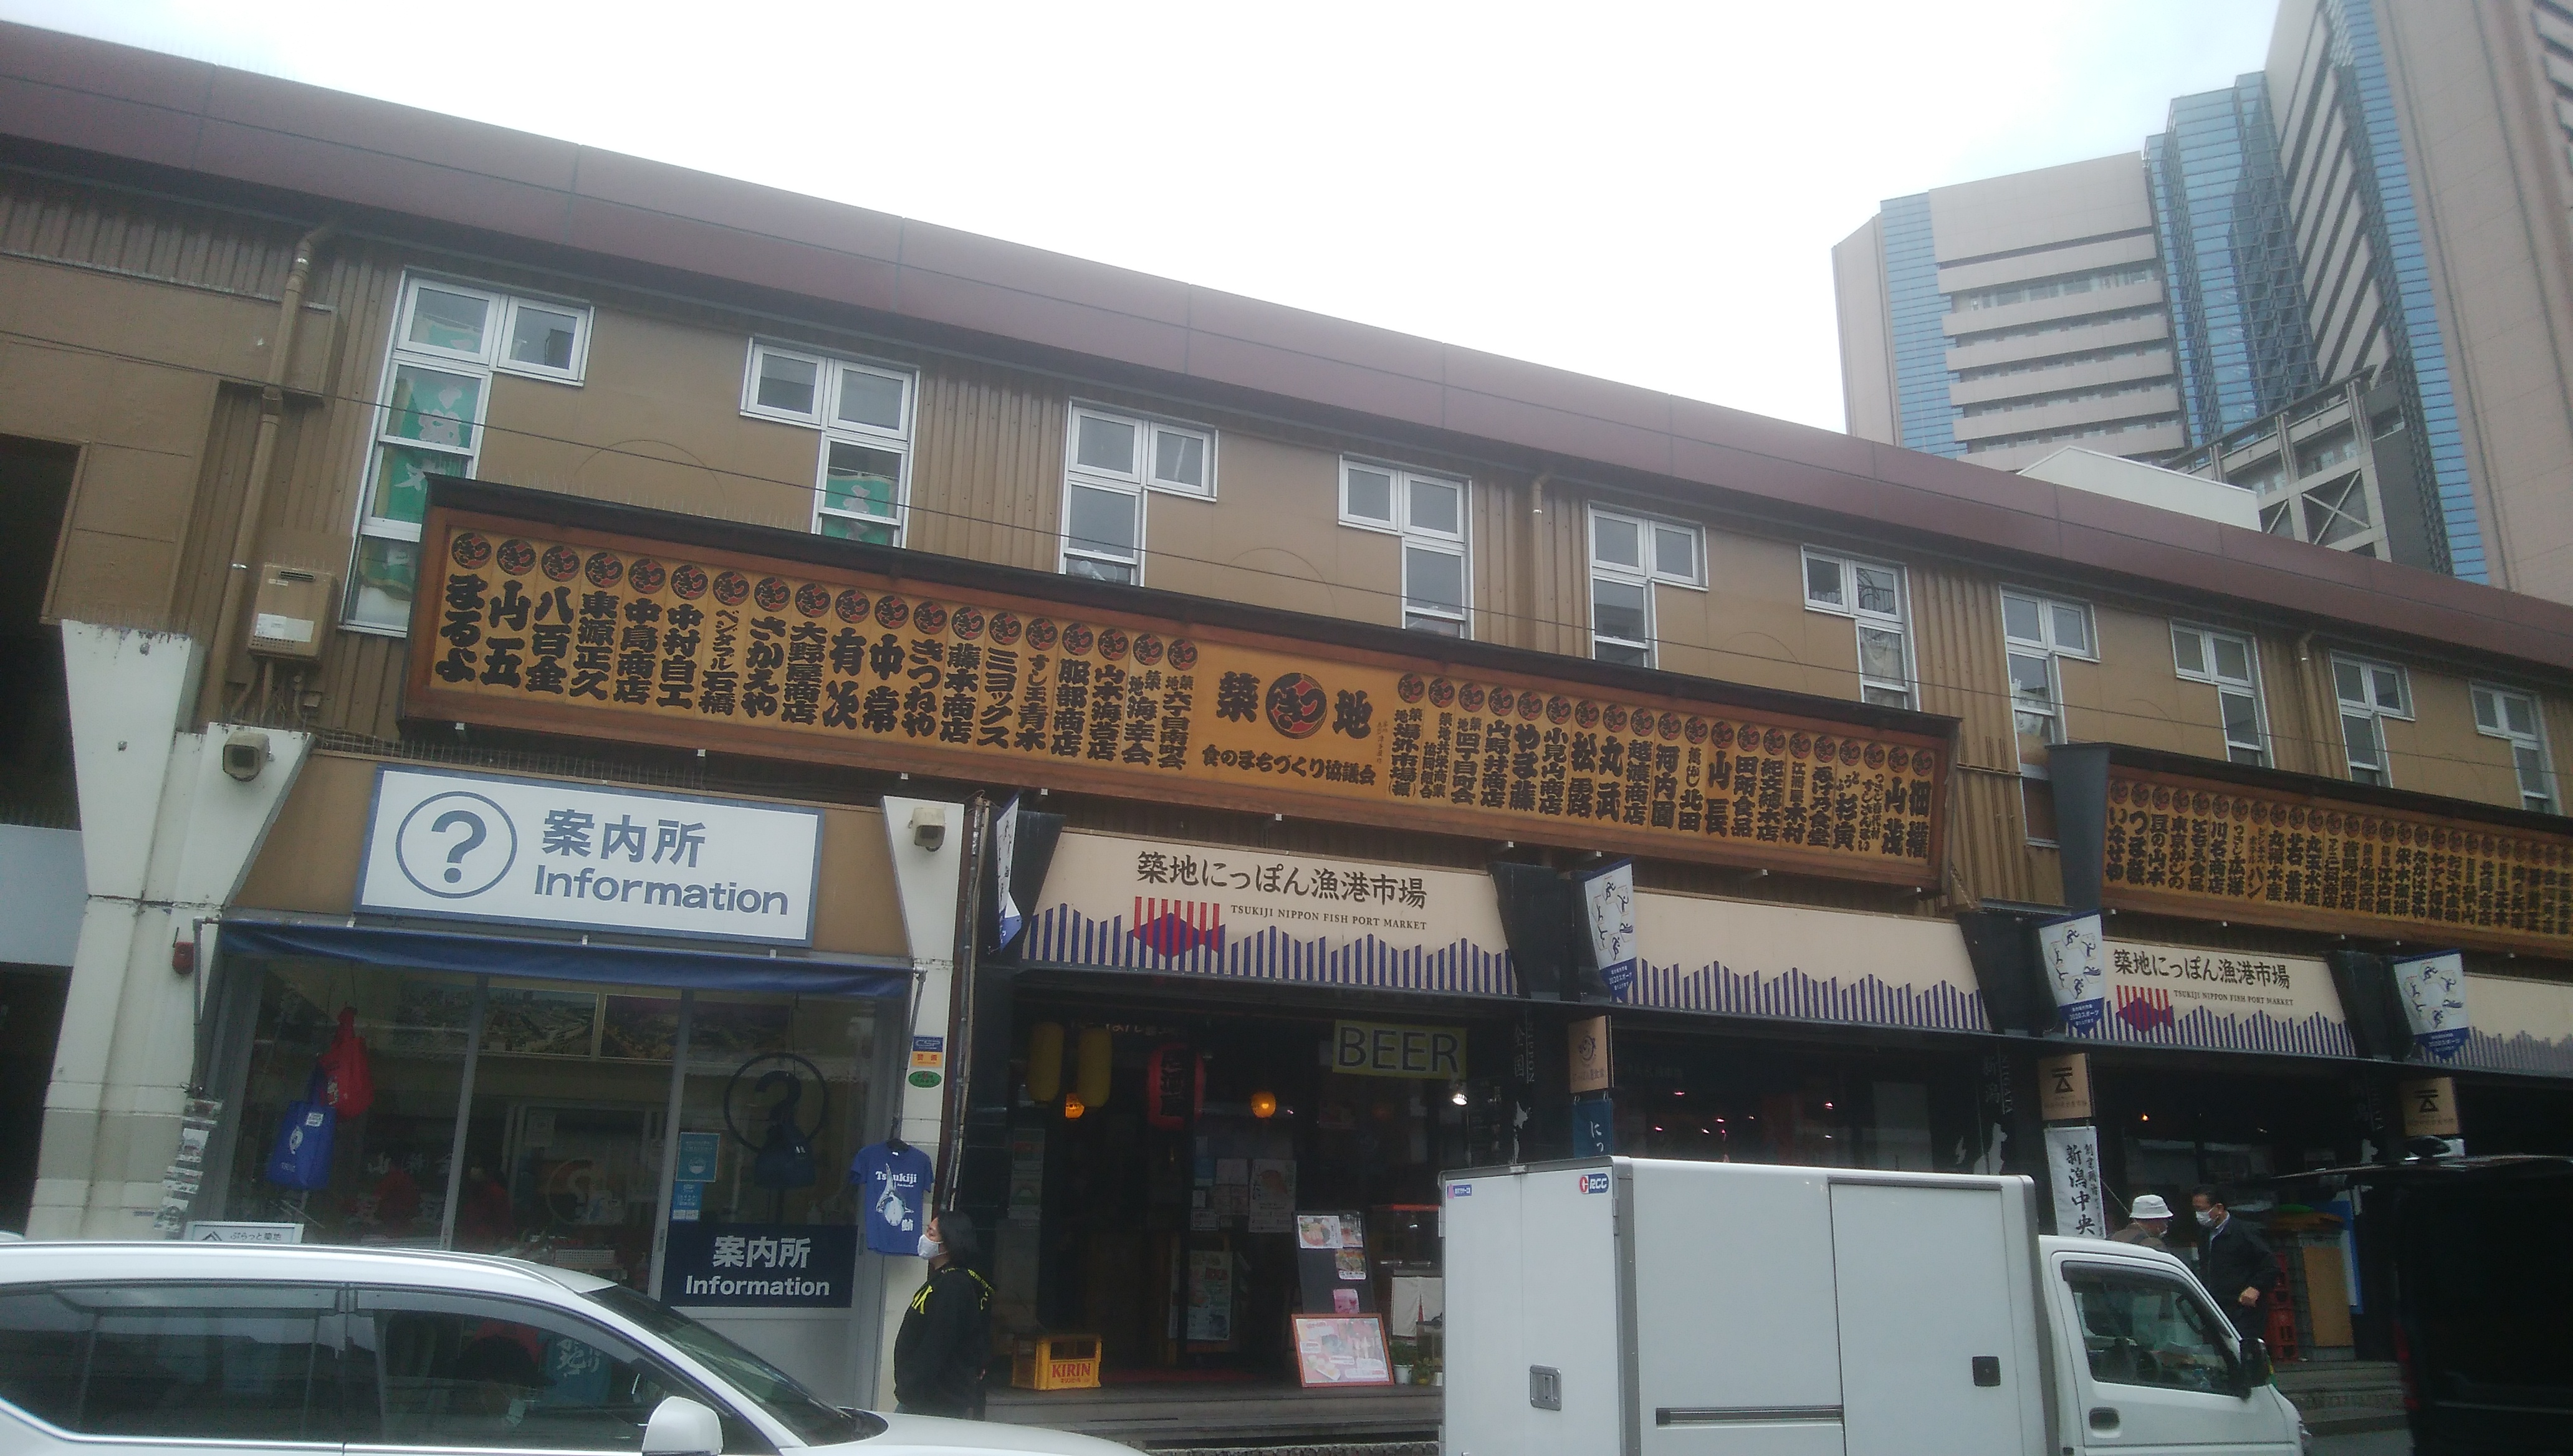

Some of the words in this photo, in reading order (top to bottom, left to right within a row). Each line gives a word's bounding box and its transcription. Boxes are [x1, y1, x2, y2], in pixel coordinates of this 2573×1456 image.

[436, 574, 488, 682] まるよ
[479, 580, 530, 688] 山五
[525, 586, 574, 695] 八百金
[568, 590, 619, 701] 東源正久
[613, 598, 663, 705] 中島商店
[656, 604, 704, 709] 中村自工
[698, 609, 739, 716] ベジタブル石橋
[822, 627, 868, 730] 有次
[862, 633, 906, 734] 中常
[901, 639, 944, 738] きつねや
[939, 643, 982, 744] 藤本商店
[1051, 658, 1091, 758] 服部商店
[1216, 671, 1260, 723] 築
[1332, 689, 1373, 740] 地
[1202, 744, 1376, 785] 食のまちづくり協議会
[542, 808, 706, 868] 案内所
[534, 864, 789, 916] Information
[1137, 850, 1427, 910] 築地にっぽん漁港市場
[1230, 904, 1273, 917] TSUKIJI
[1278, 909, 1320, 921] NIPPON
[1323, 912, 1349, 924] FISH
[1352, 916, 1380, 927] PORT
[1383, 919, 1427, 931] MARKET
[2113, 948, 2291, 990] 築地にっぽん漁港市場
[2202, 991, 2228, 1002] NIPPON
[2266, 997, 2294, 1007] MARKET
[1338, 1025, 1460, 1073] BEER
[875, 1171, 918, 1184] Tsukiji
[2066, 1143, 2095, 1235] 新潟中央
[686, 1275, 830, 1296] Information
[712, 1235, 811, 1268] 案内所
[1052, 1363, 1090, 1378] KIRIN
